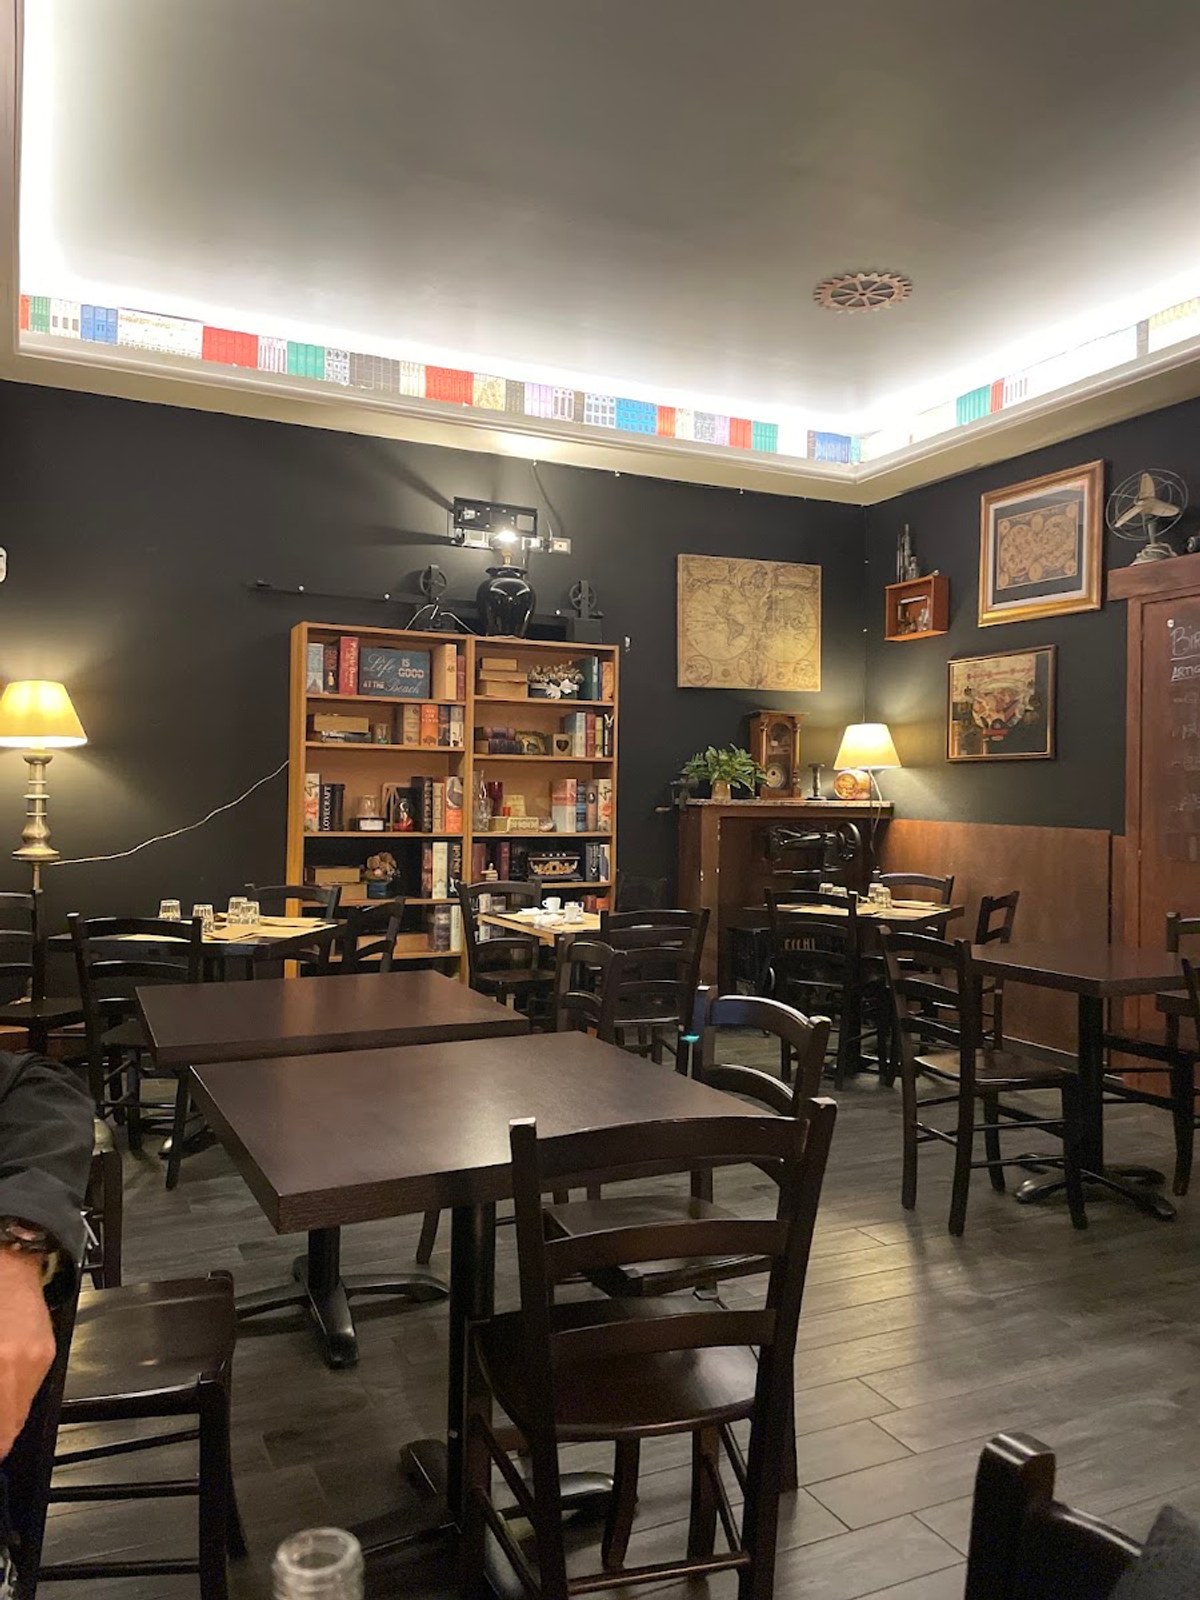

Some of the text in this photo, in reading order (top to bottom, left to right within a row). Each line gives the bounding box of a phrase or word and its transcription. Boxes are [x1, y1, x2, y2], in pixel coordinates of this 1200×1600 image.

[363, 653, 410, 678] Life IS
[398, 668, 425, 679] GOOD
[373, 681, 385, 689] THE
[385, 678, 422, 694] Beach
[322, 786, 331, 831] LOVECRAFT
